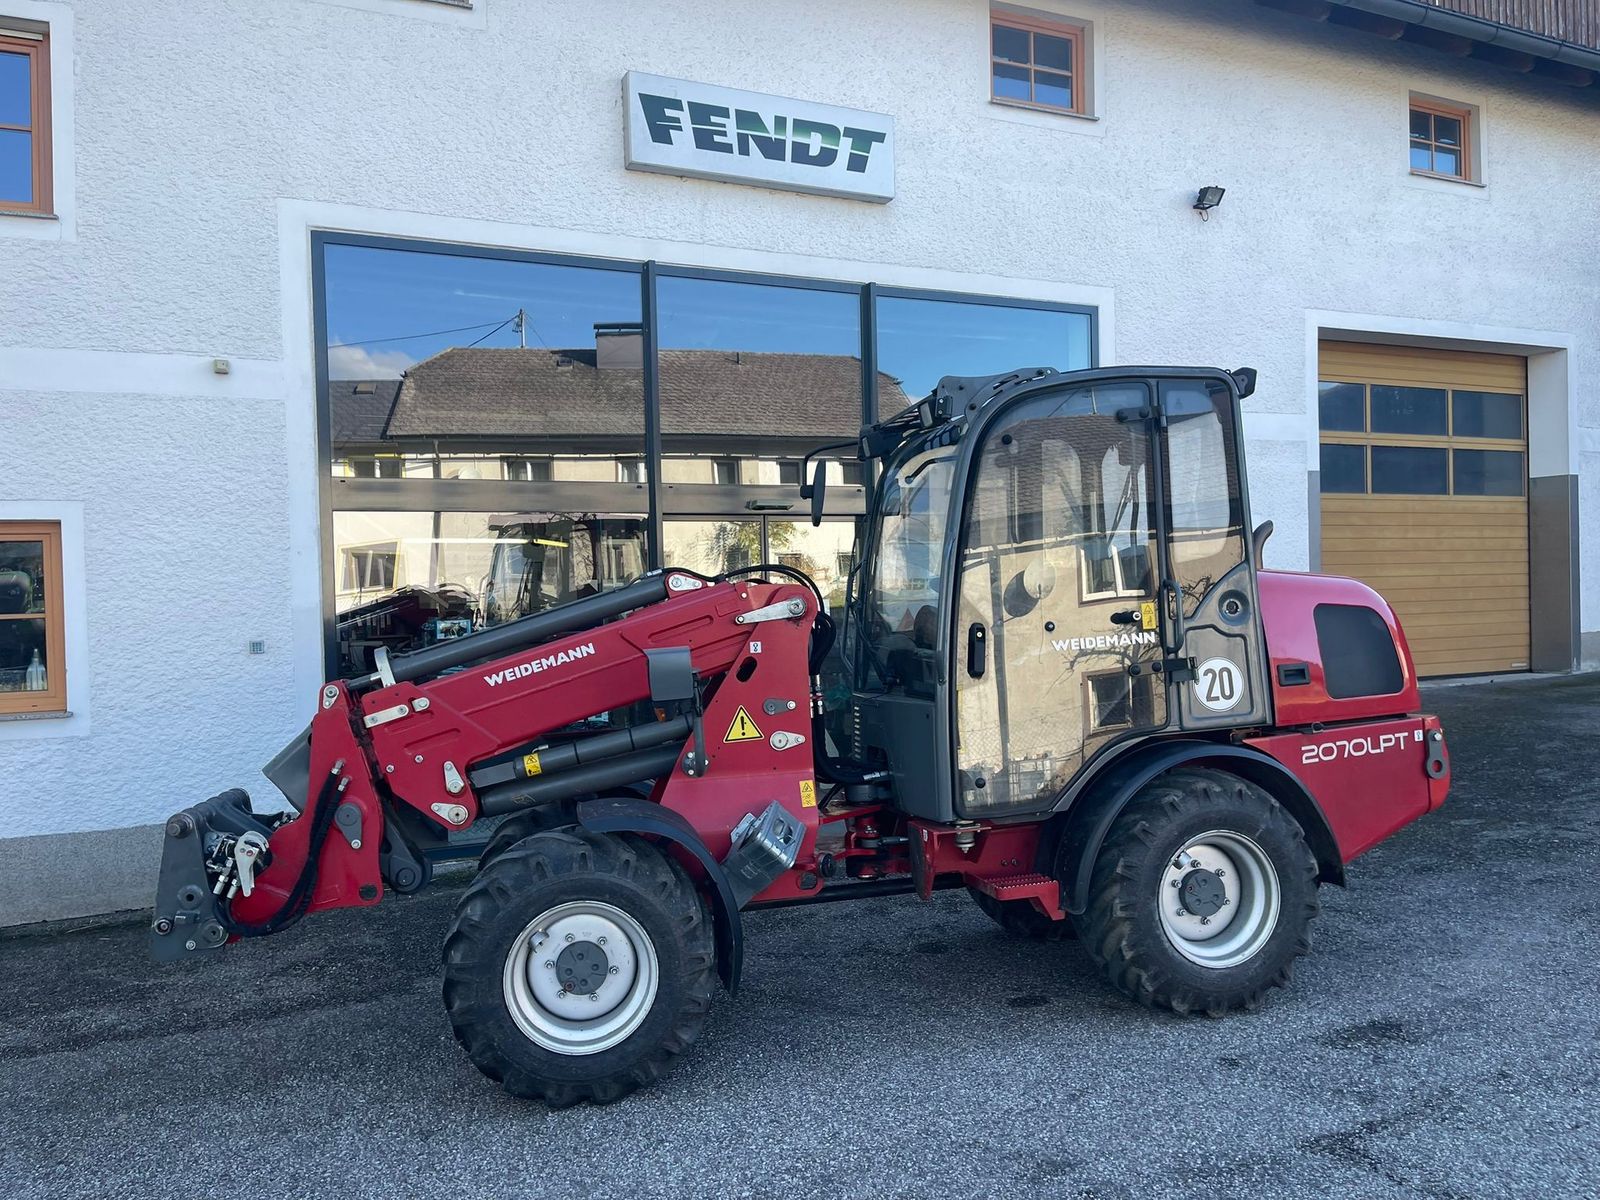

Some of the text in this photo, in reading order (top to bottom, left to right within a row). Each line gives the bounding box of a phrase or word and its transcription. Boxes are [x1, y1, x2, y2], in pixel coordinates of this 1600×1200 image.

[638, 93, 886, 173] FENDT
[1051, 631, 1156, 651] WEIDEMANN
[483, 642, 596, 687] WEIDEMANN
[1202, 666, 1235, 702] 20
[1301, 732, 1409, 764] 2070LPT
